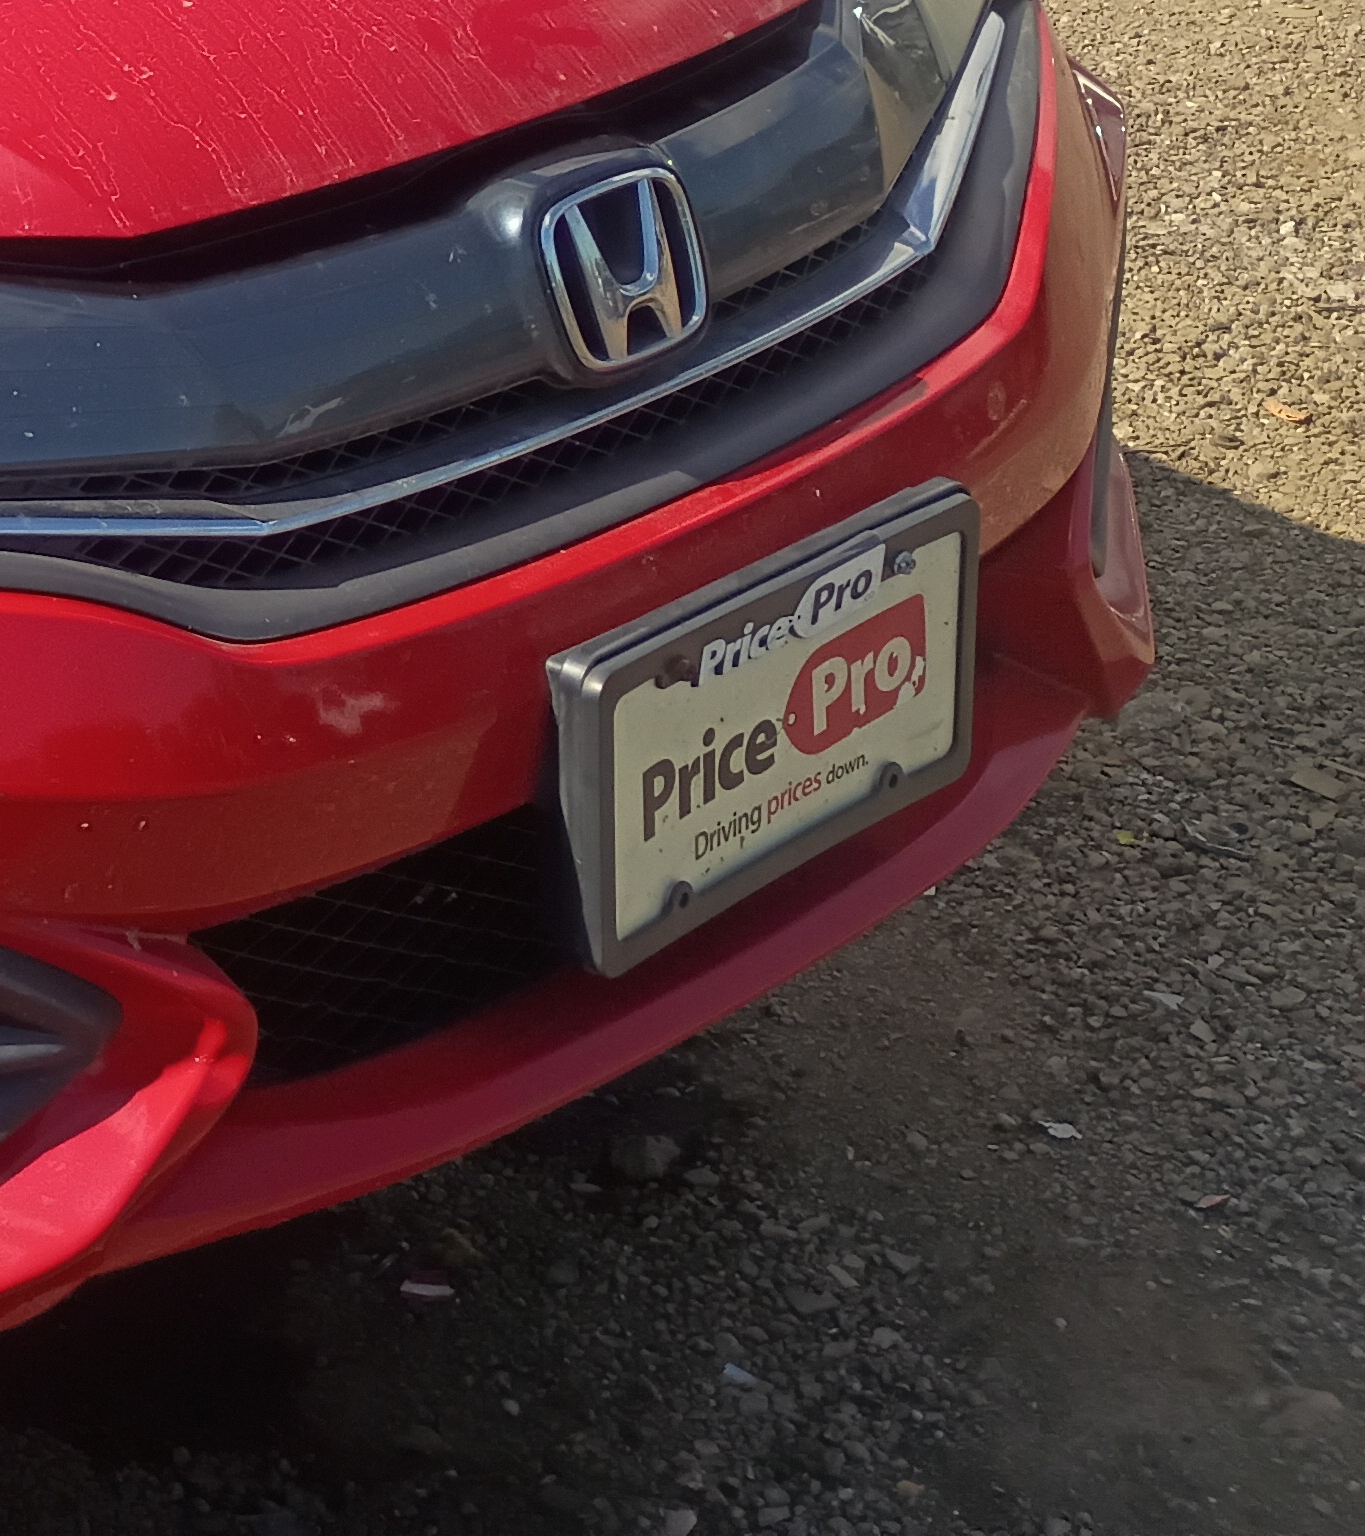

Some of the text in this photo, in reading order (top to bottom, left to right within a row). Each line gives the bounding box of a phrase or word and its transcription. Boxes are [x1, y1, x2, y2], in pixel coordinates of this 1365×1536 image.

[698, 566, 874, 686] Price Pro
[641, 635, 913, 843] Price Pro
[694, 752, 870, 861] Driving prices down.
